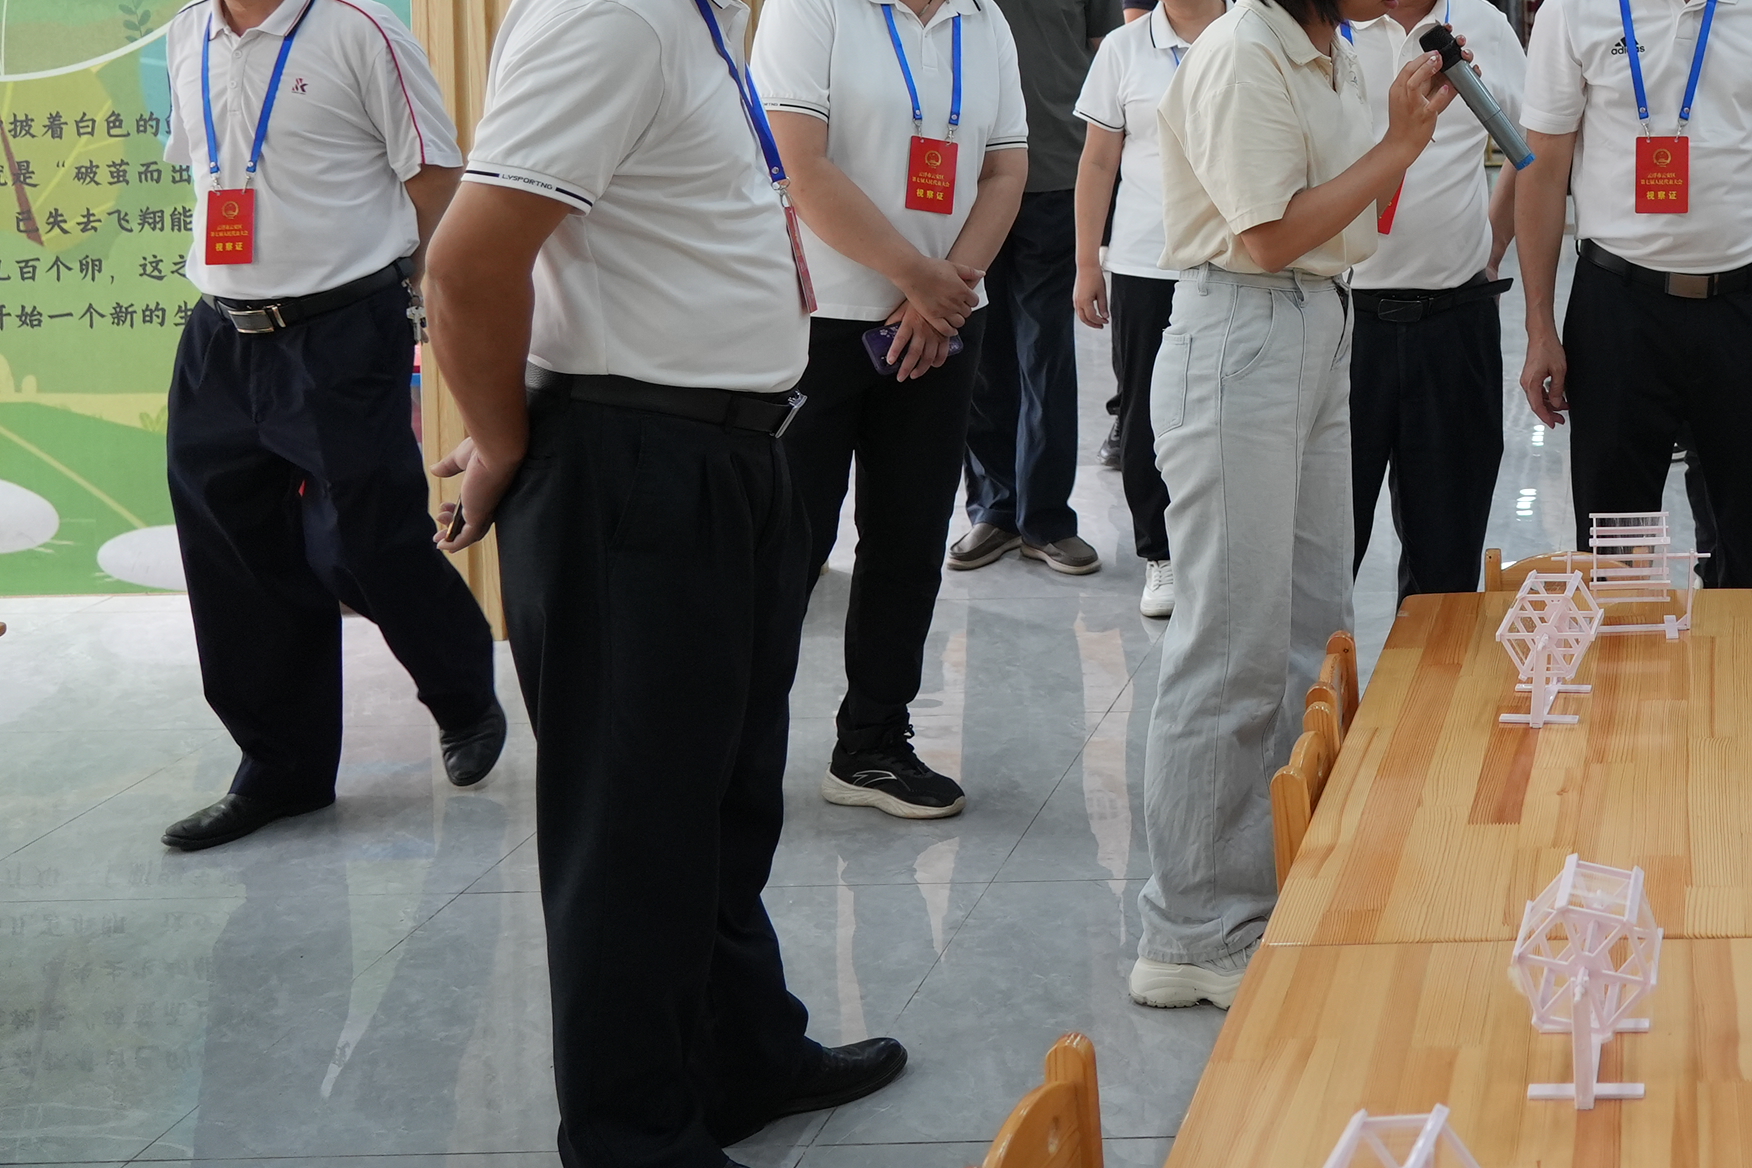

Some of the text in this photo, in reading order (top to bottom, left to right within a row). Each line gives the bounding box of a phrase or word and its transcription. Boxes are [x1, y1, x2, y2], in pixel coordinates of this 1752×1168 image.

[1611, 45, 1646, 55] adis
[0, 159, 193, 189] 是“破茧而出
[916, 188, 945, 201] 视察证
[1646, 190, 1677, 200] 视察证
